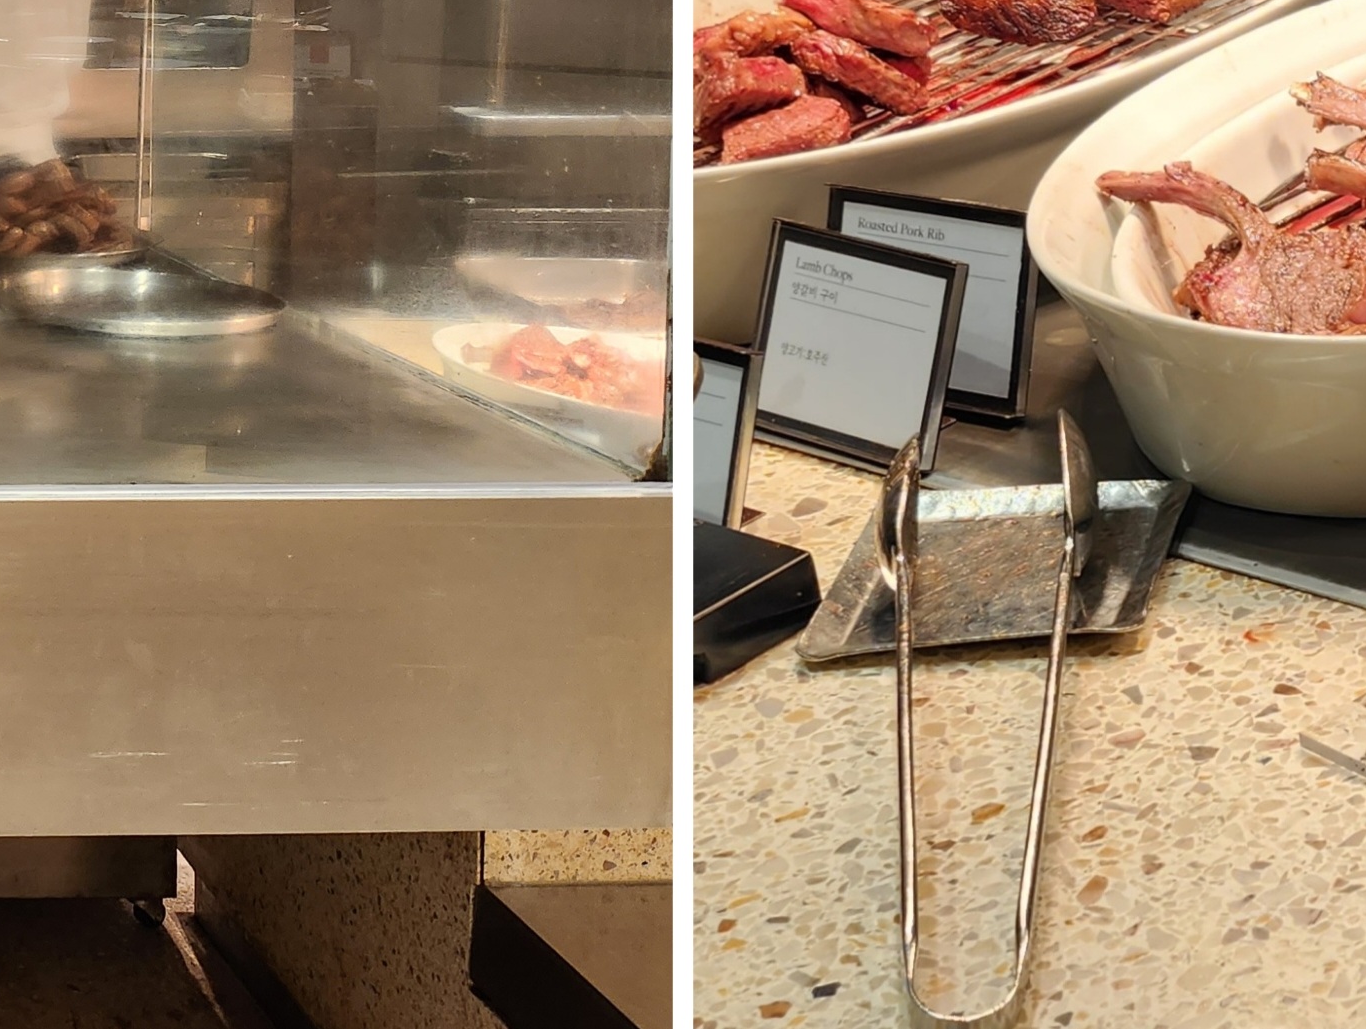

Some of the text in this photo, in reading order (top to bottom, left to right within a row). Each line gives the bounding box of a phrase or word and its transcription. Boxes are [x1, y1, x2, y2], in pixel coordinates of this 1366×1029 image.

[857, 216, 945, 241] Roasted Pork Rib
[795, 256, 853, 284] Lamb Chops
